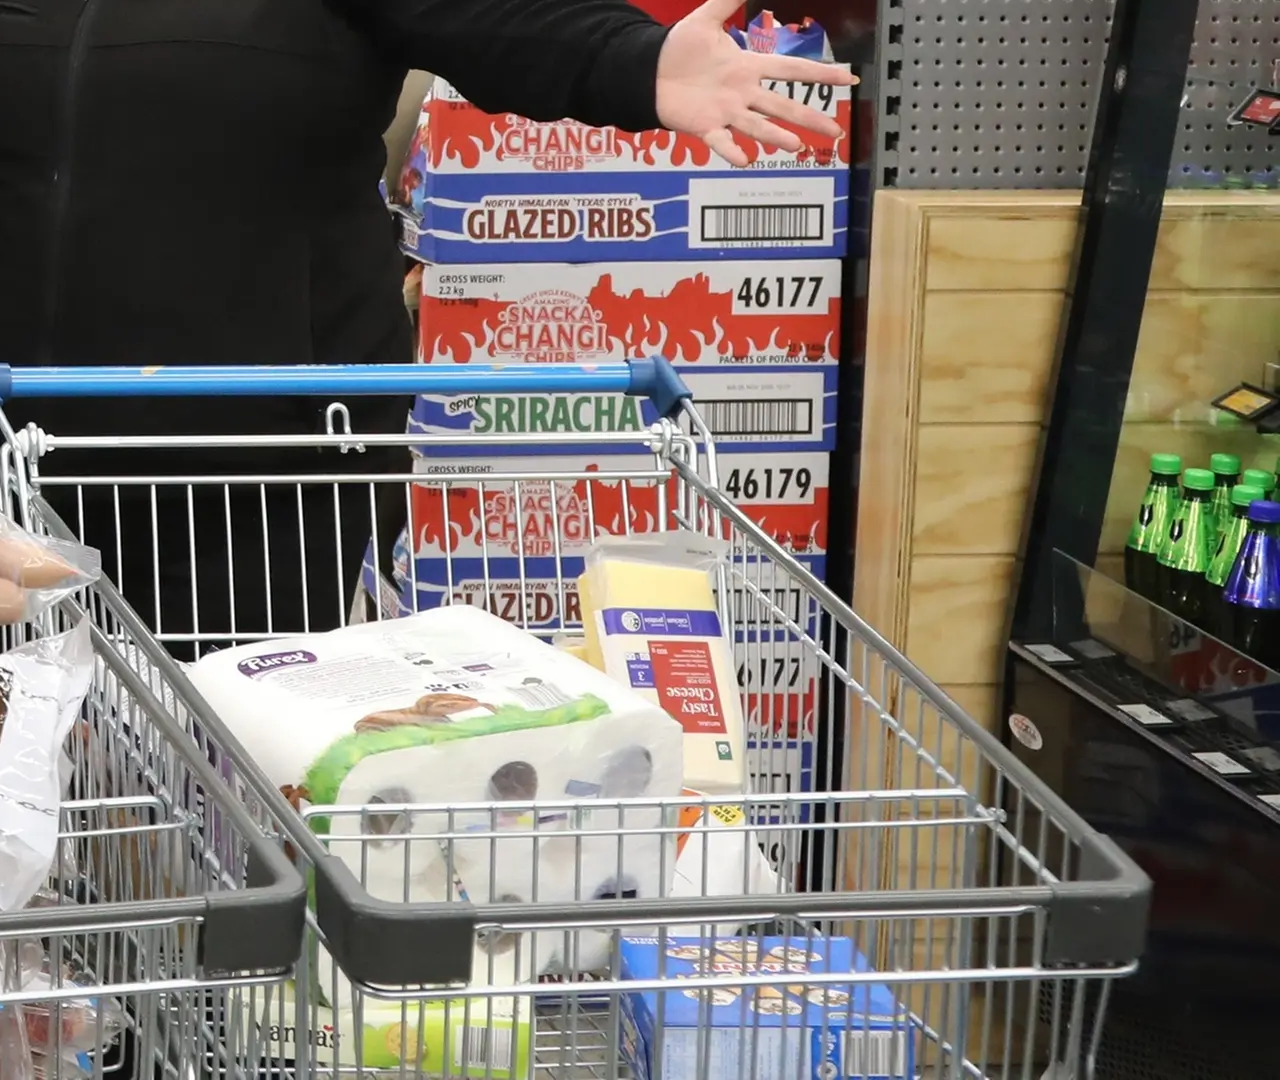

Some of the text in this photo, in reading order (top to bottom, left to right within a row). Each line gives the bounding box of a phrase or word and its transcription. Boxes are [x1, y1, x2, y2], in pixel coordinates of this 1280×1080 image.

[502, 126, 617, 158] CHANGI
[532, 155, 585, 173] CHIPS
[780, 160, 812, 169] POTATO
[485, 198, 516, 208] NORTH
[518, 197, 572, 208] HIMALAYAN
[467, 206, 653, 241] GLAZED RIBS
[439, 273, 506, 285] GROSS WEIGHT:
[438, 286, 465, 298] 2.2 kg
[736, 276, 824, 308] 46177
[534, 297, 572, 307] AMAZING
[507, 306, 593, 321] SNACKA
[495, 323, 608, 352] CHANGI
[770, 355, 802, 364] POTATO
[448, 395, 482, 415] SPICY
[474, 395, 642, 433] SRIRACHA
[725, 468, 813, 500] 46179
[493, 496, 580, 513] SNACKA
[240, 650, 310, 671] Purex
[637, 670, 646, 682] 3
[666, 686, 715, 701] Cheese
[681, 699, 719, 718] Tasty
